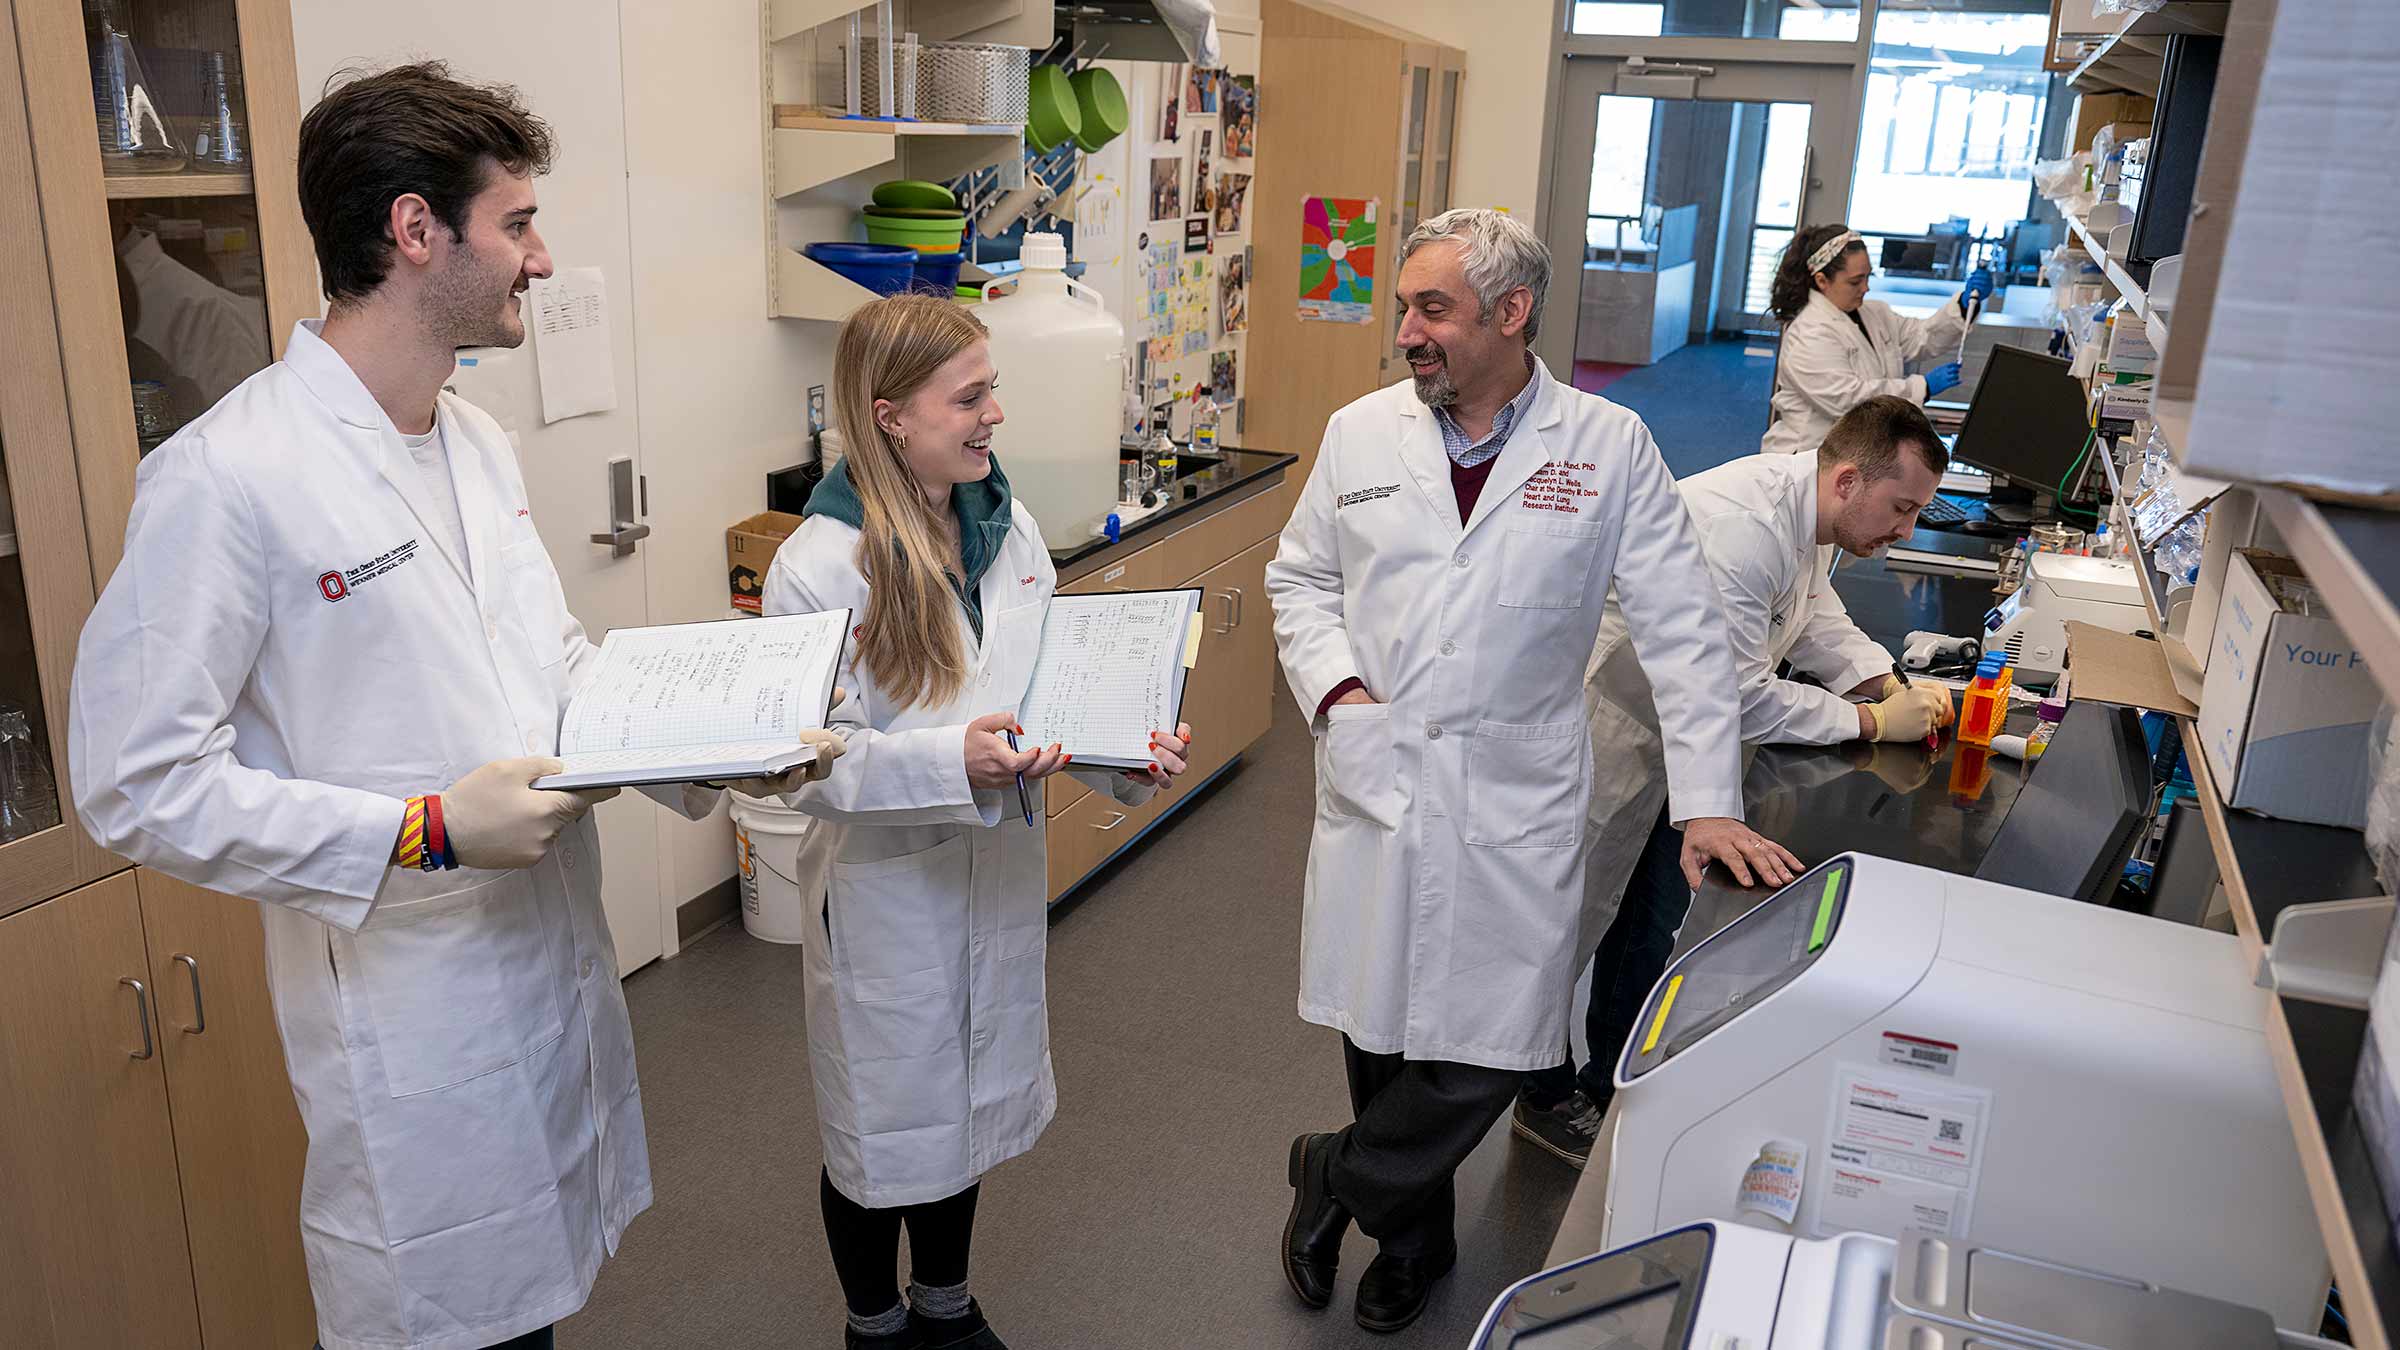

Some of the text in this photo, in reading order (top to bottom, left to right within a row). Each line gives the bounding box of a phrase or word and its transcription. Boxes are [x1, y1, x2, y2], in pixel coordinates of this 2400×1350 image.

[1582, 463, 1596, 471] PhD
[1525, 483, 1538, 491] Chair
[1556, 486, 1576, 496] Dorothy
[1523, 492, 1541, 501] Heart
[1556, 495, 1570, 505] Lung
[1522, 500, 1579, 514] Research Institute
[2286, 643, 2343, 667] Your
